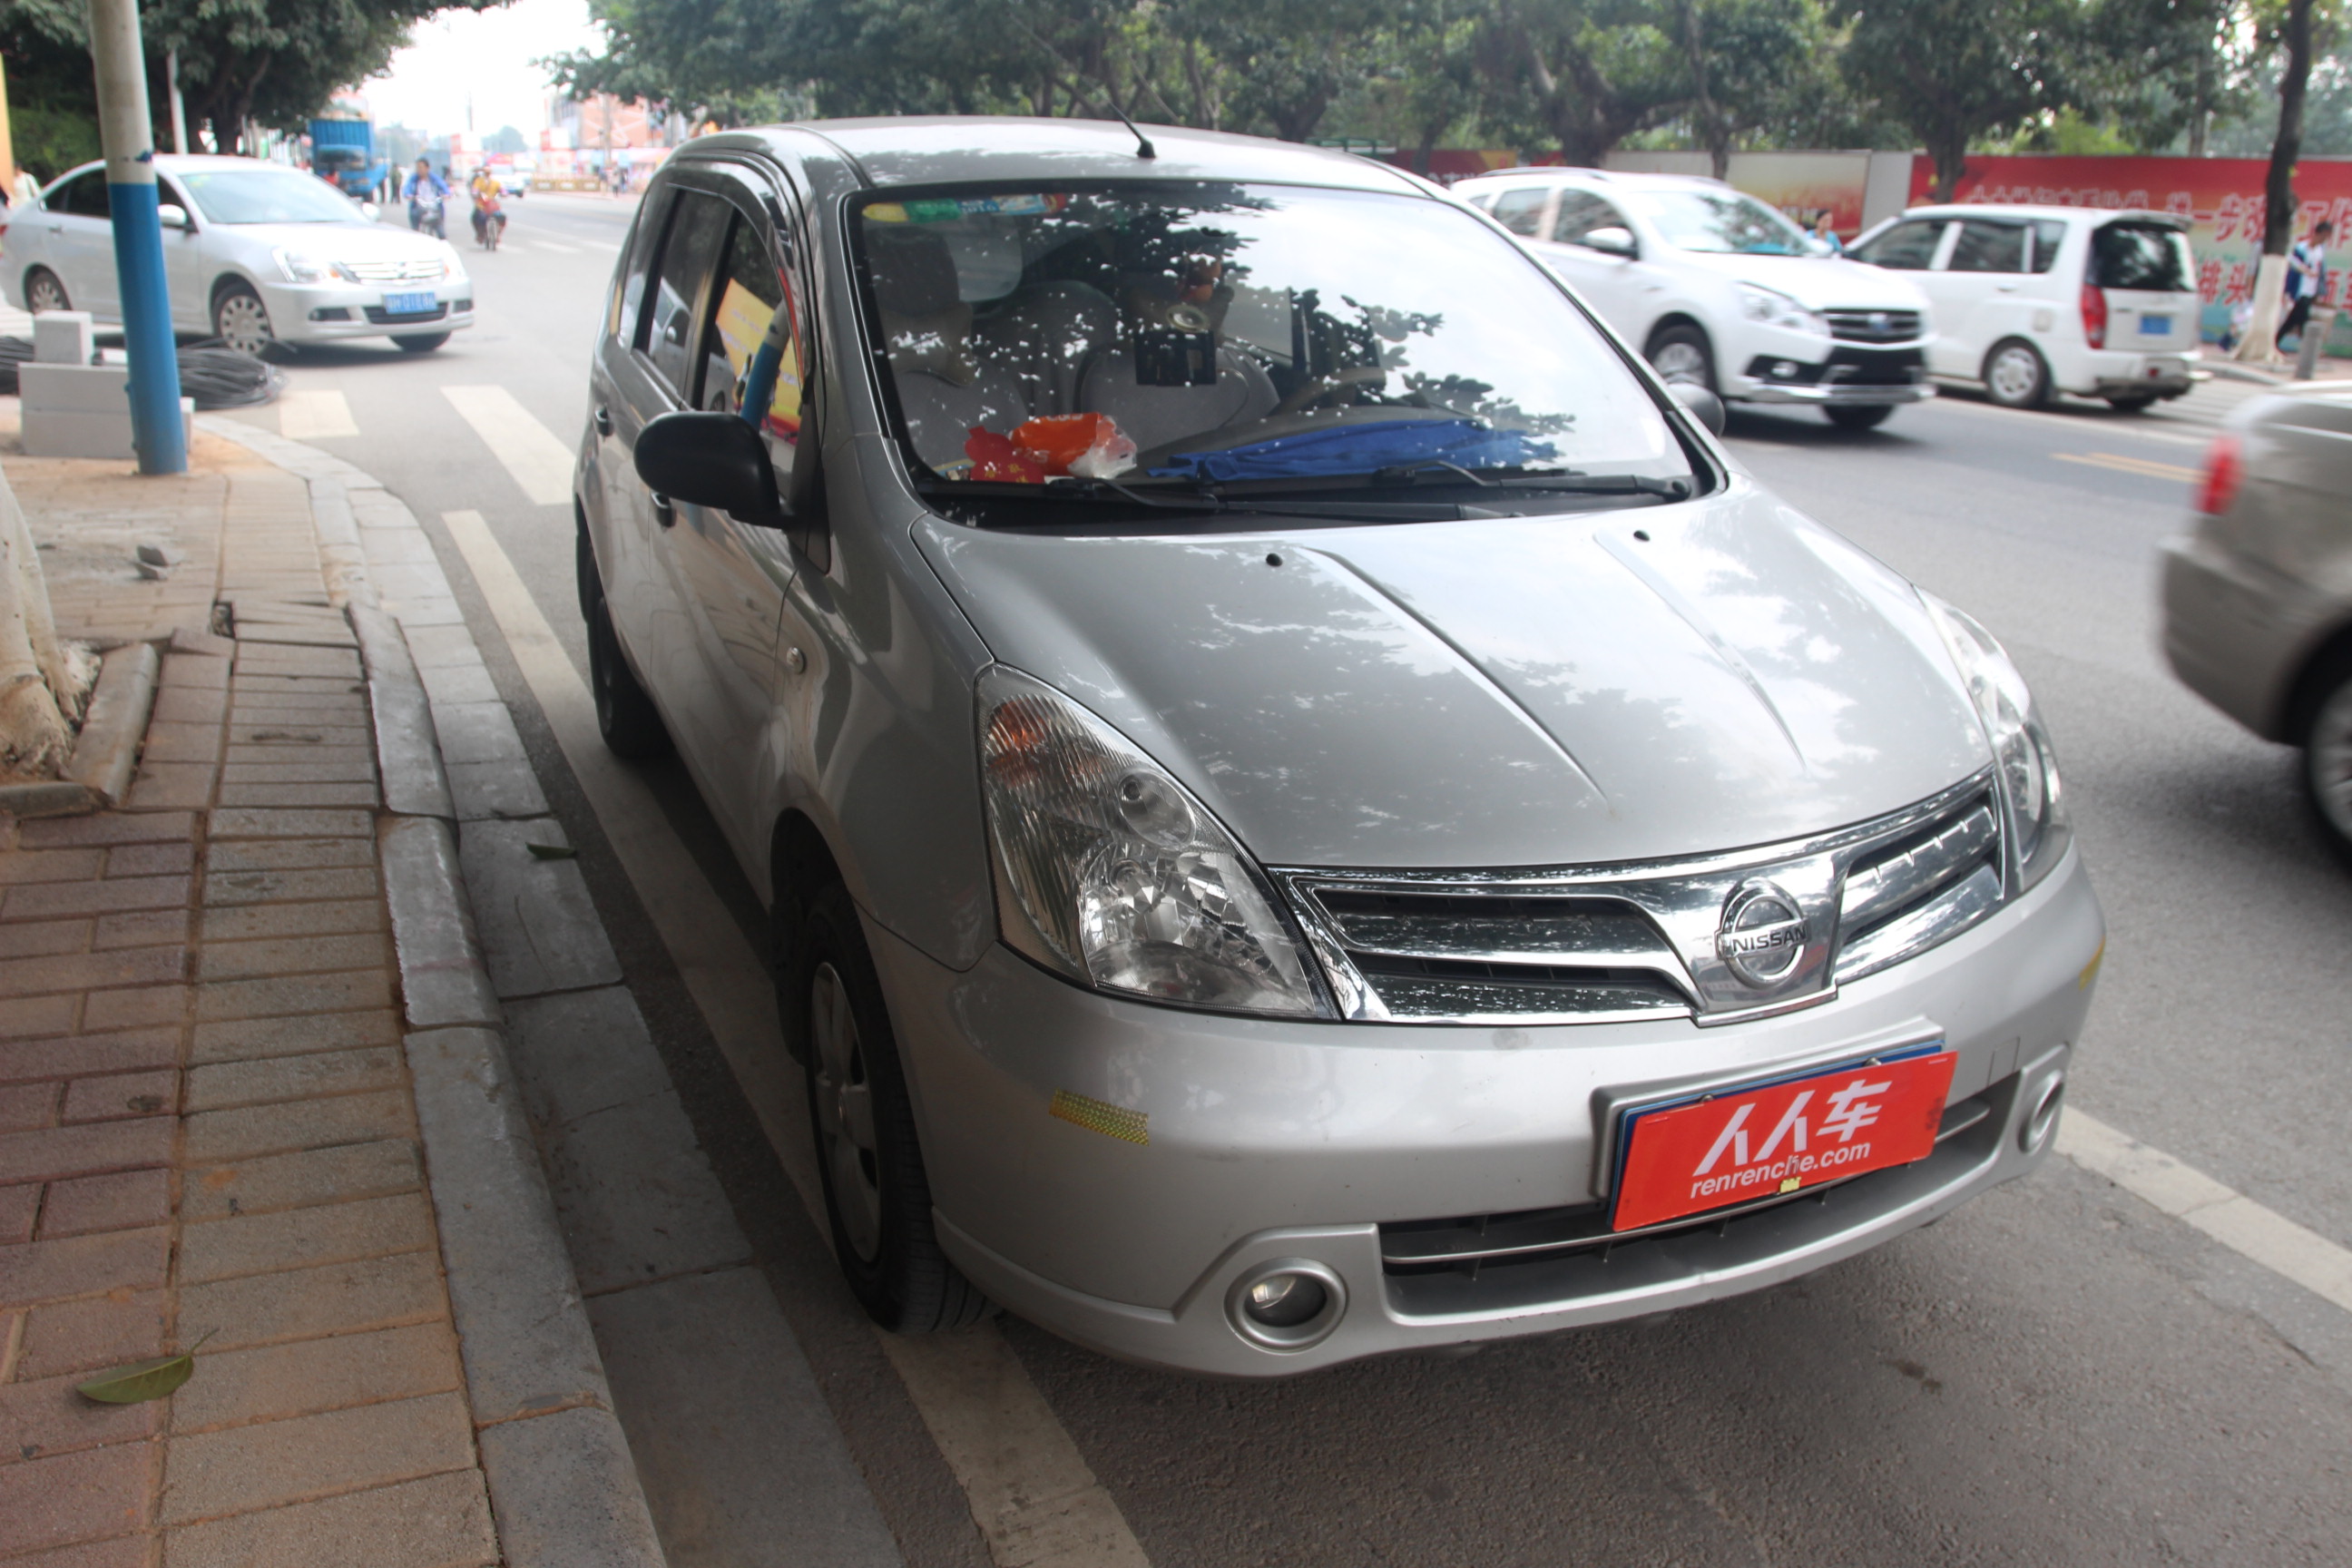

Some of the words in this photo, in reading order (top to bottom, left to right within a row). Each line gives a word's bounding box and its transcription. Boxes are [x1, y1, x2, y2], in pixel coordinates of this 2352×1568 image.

[1732, 926, 1808, 953] NISSAN
[1692, 1079, 1892, 1177] 人人车
[1690, 1141, 1870, 1199] renrenche.com
